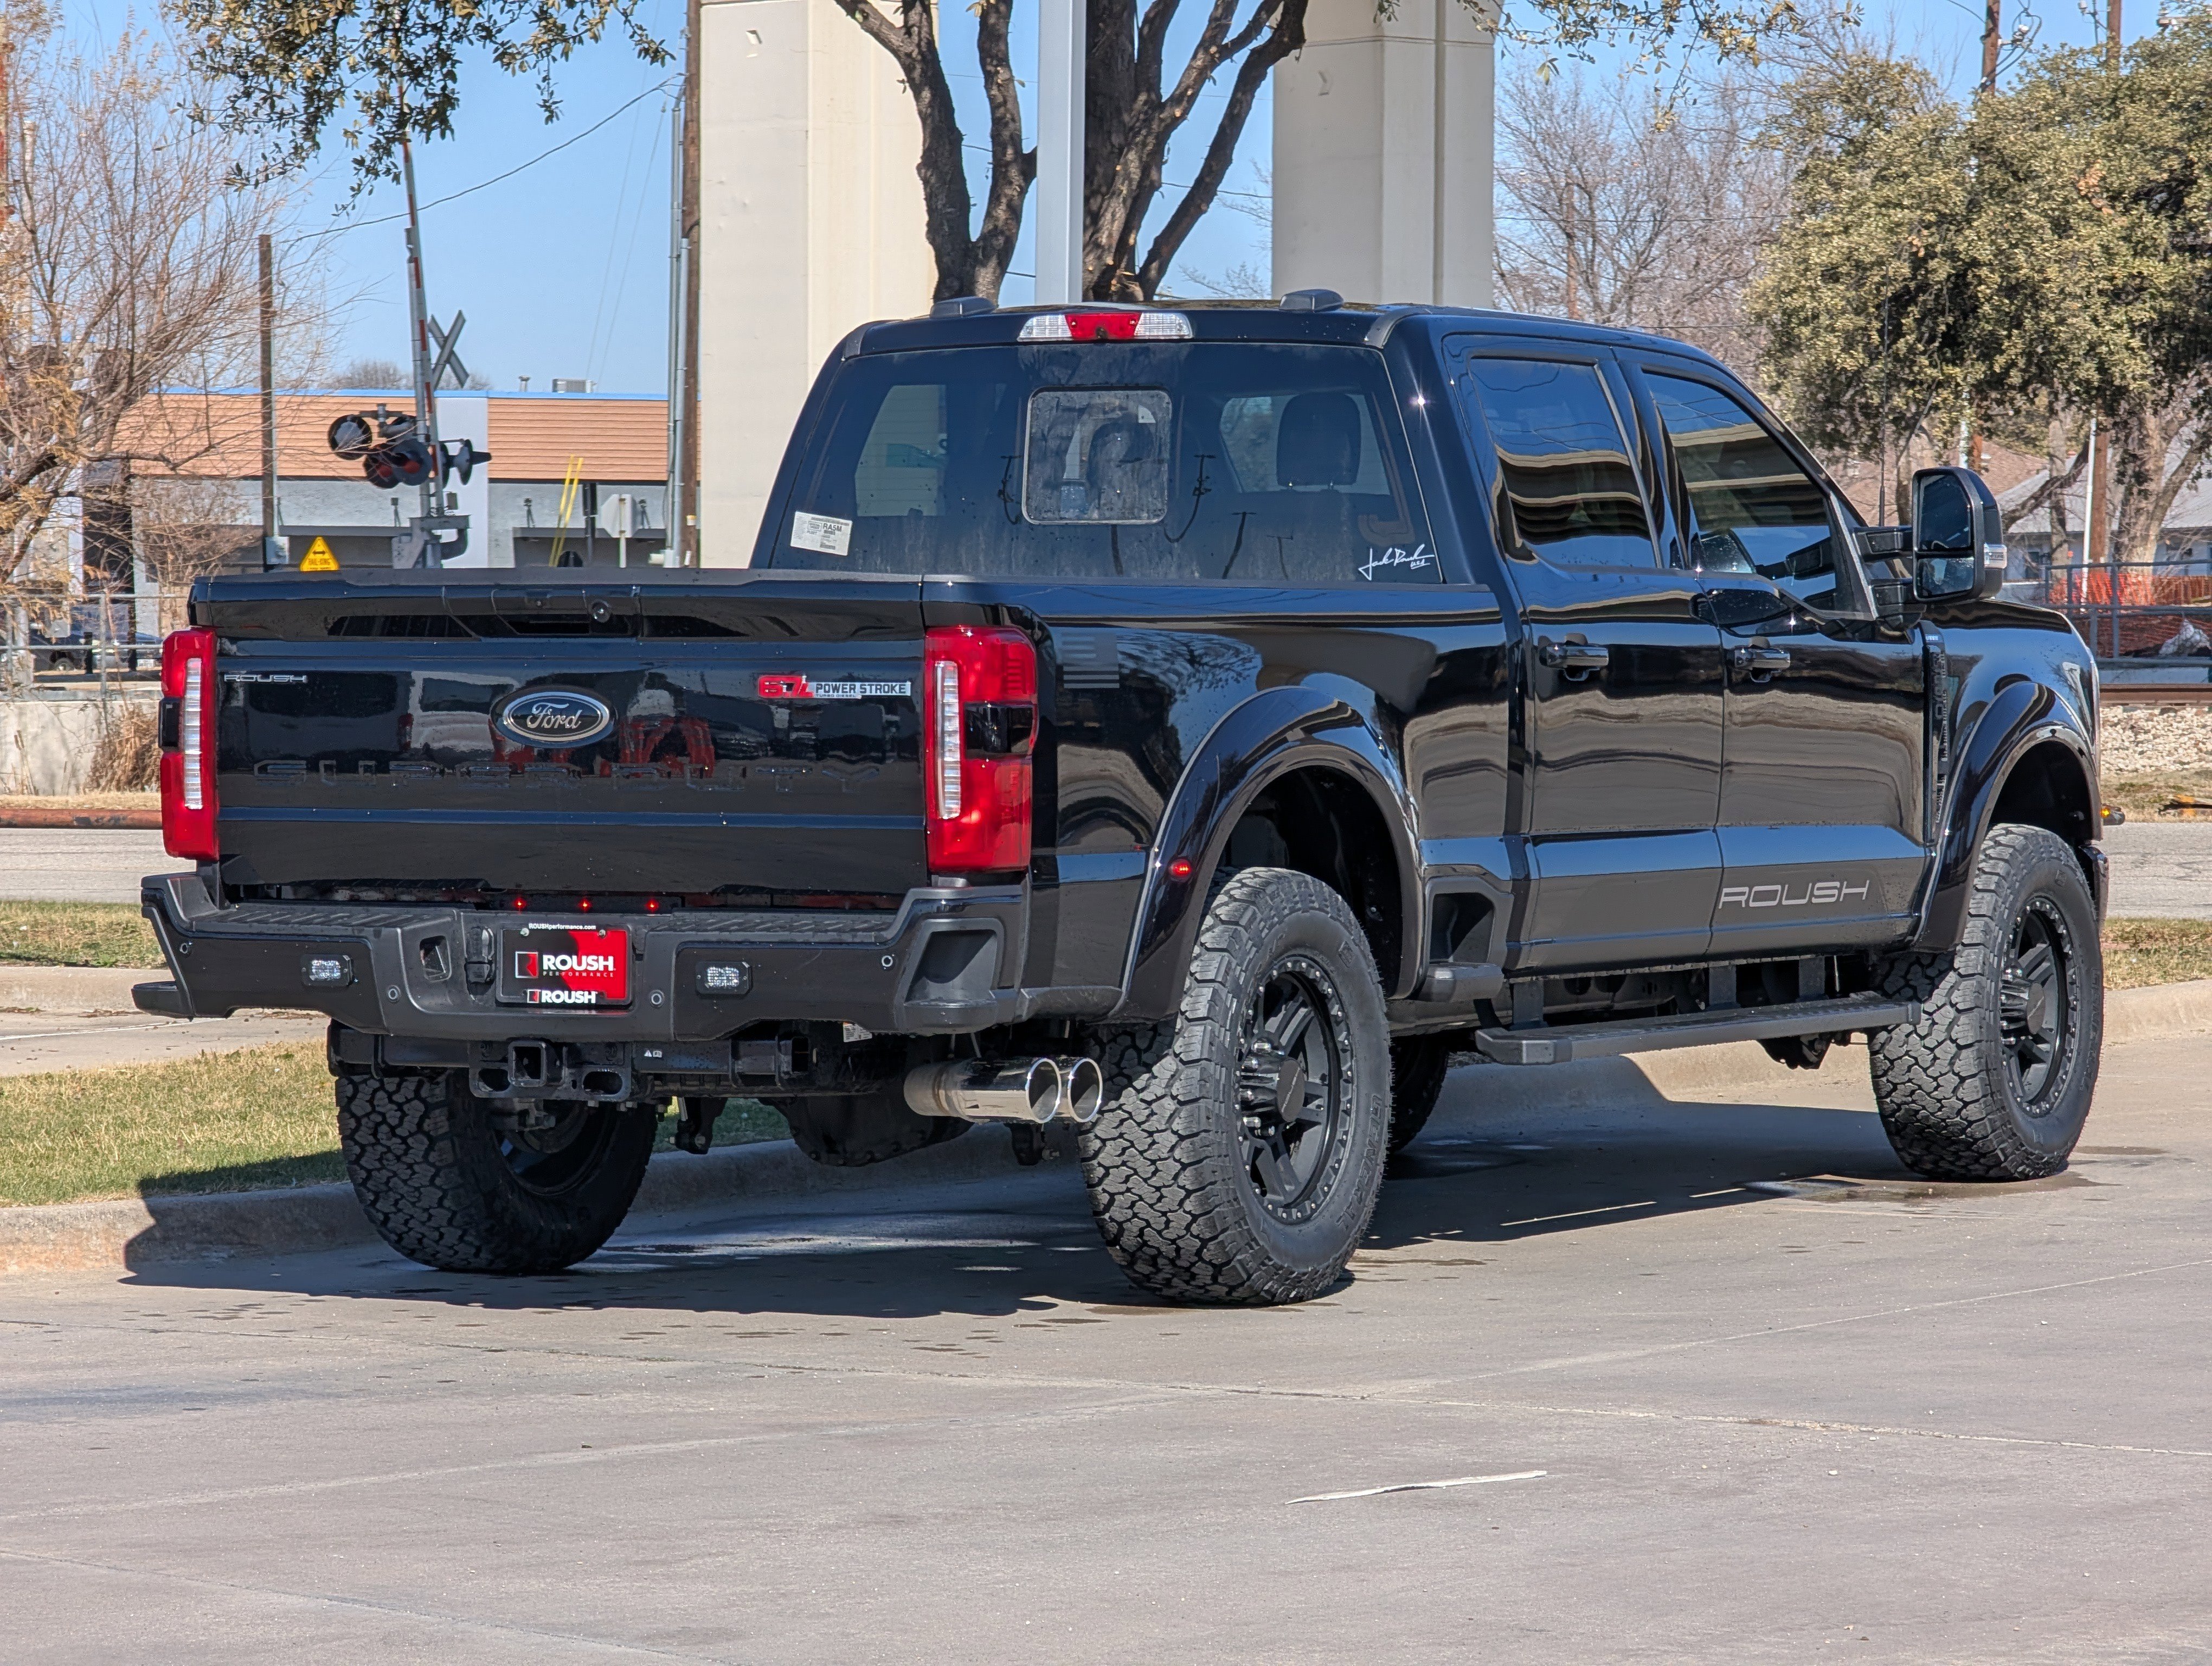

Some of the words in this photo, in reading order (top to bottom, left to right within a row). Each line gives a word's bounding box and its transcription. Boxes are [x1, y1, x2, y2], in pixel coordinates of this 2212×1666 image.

[224, 675, 308, 683] ROUSH
[758, 675, 814, 699] 6.7L
[815, 683, 857, 694] POWER
[859, 683, 906, 694] STROKE
[526, 702, 583, 729] Ford
[610, 760, 880, 793] DUTY
[1718, 880, 1870, 909] ROUSH
[543, 954, 614, 972] ROUSH
[541, 990, 596, 1004] ROUSH
